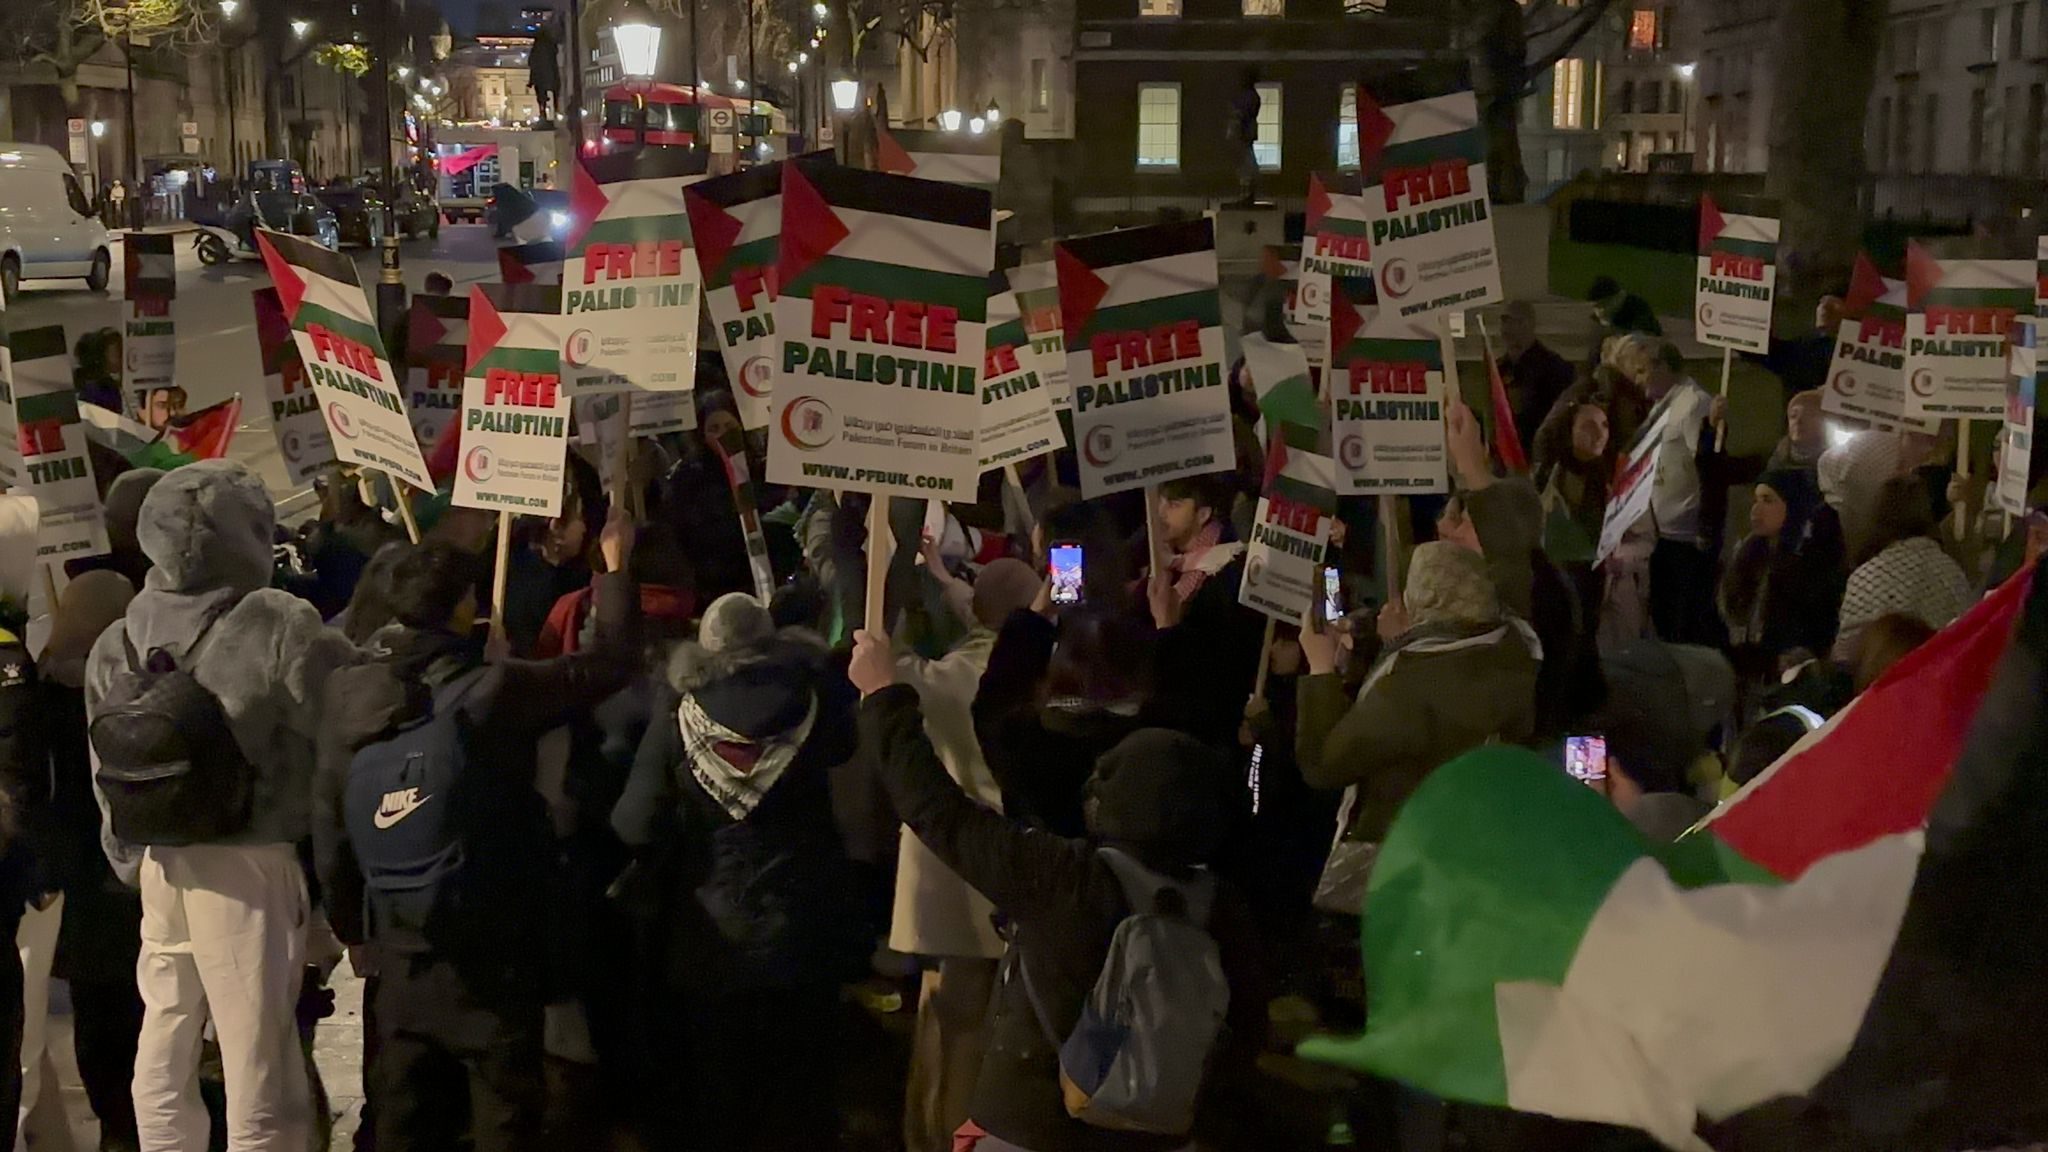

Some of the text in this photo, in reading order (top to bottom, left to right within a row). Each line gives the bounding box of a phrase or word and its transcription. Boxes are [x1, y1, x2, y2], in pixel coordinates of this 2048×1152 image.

[1382, 157, 1471, 213] FREE
[1372, 198, 1488, 246] PALESTINE
[583, 239, 684, 285] FREE
[810, 283, 959, 354] FREE
[303, 322, 384, 383] FREE
[782, 340, 977, 395] PALESTINE
[1089, 318, 1203, 379] FREE
[483, 367, 562, 409] FREE
[1076, 362, 1222, 413] PALESTINE
[1348, 357, 1428, 395] FREE
[466, 408, 565, 438] PALESTINE
[1336, 398, 1441, 421] PALESTINE
[382, 786, 419, 814] NIKE
